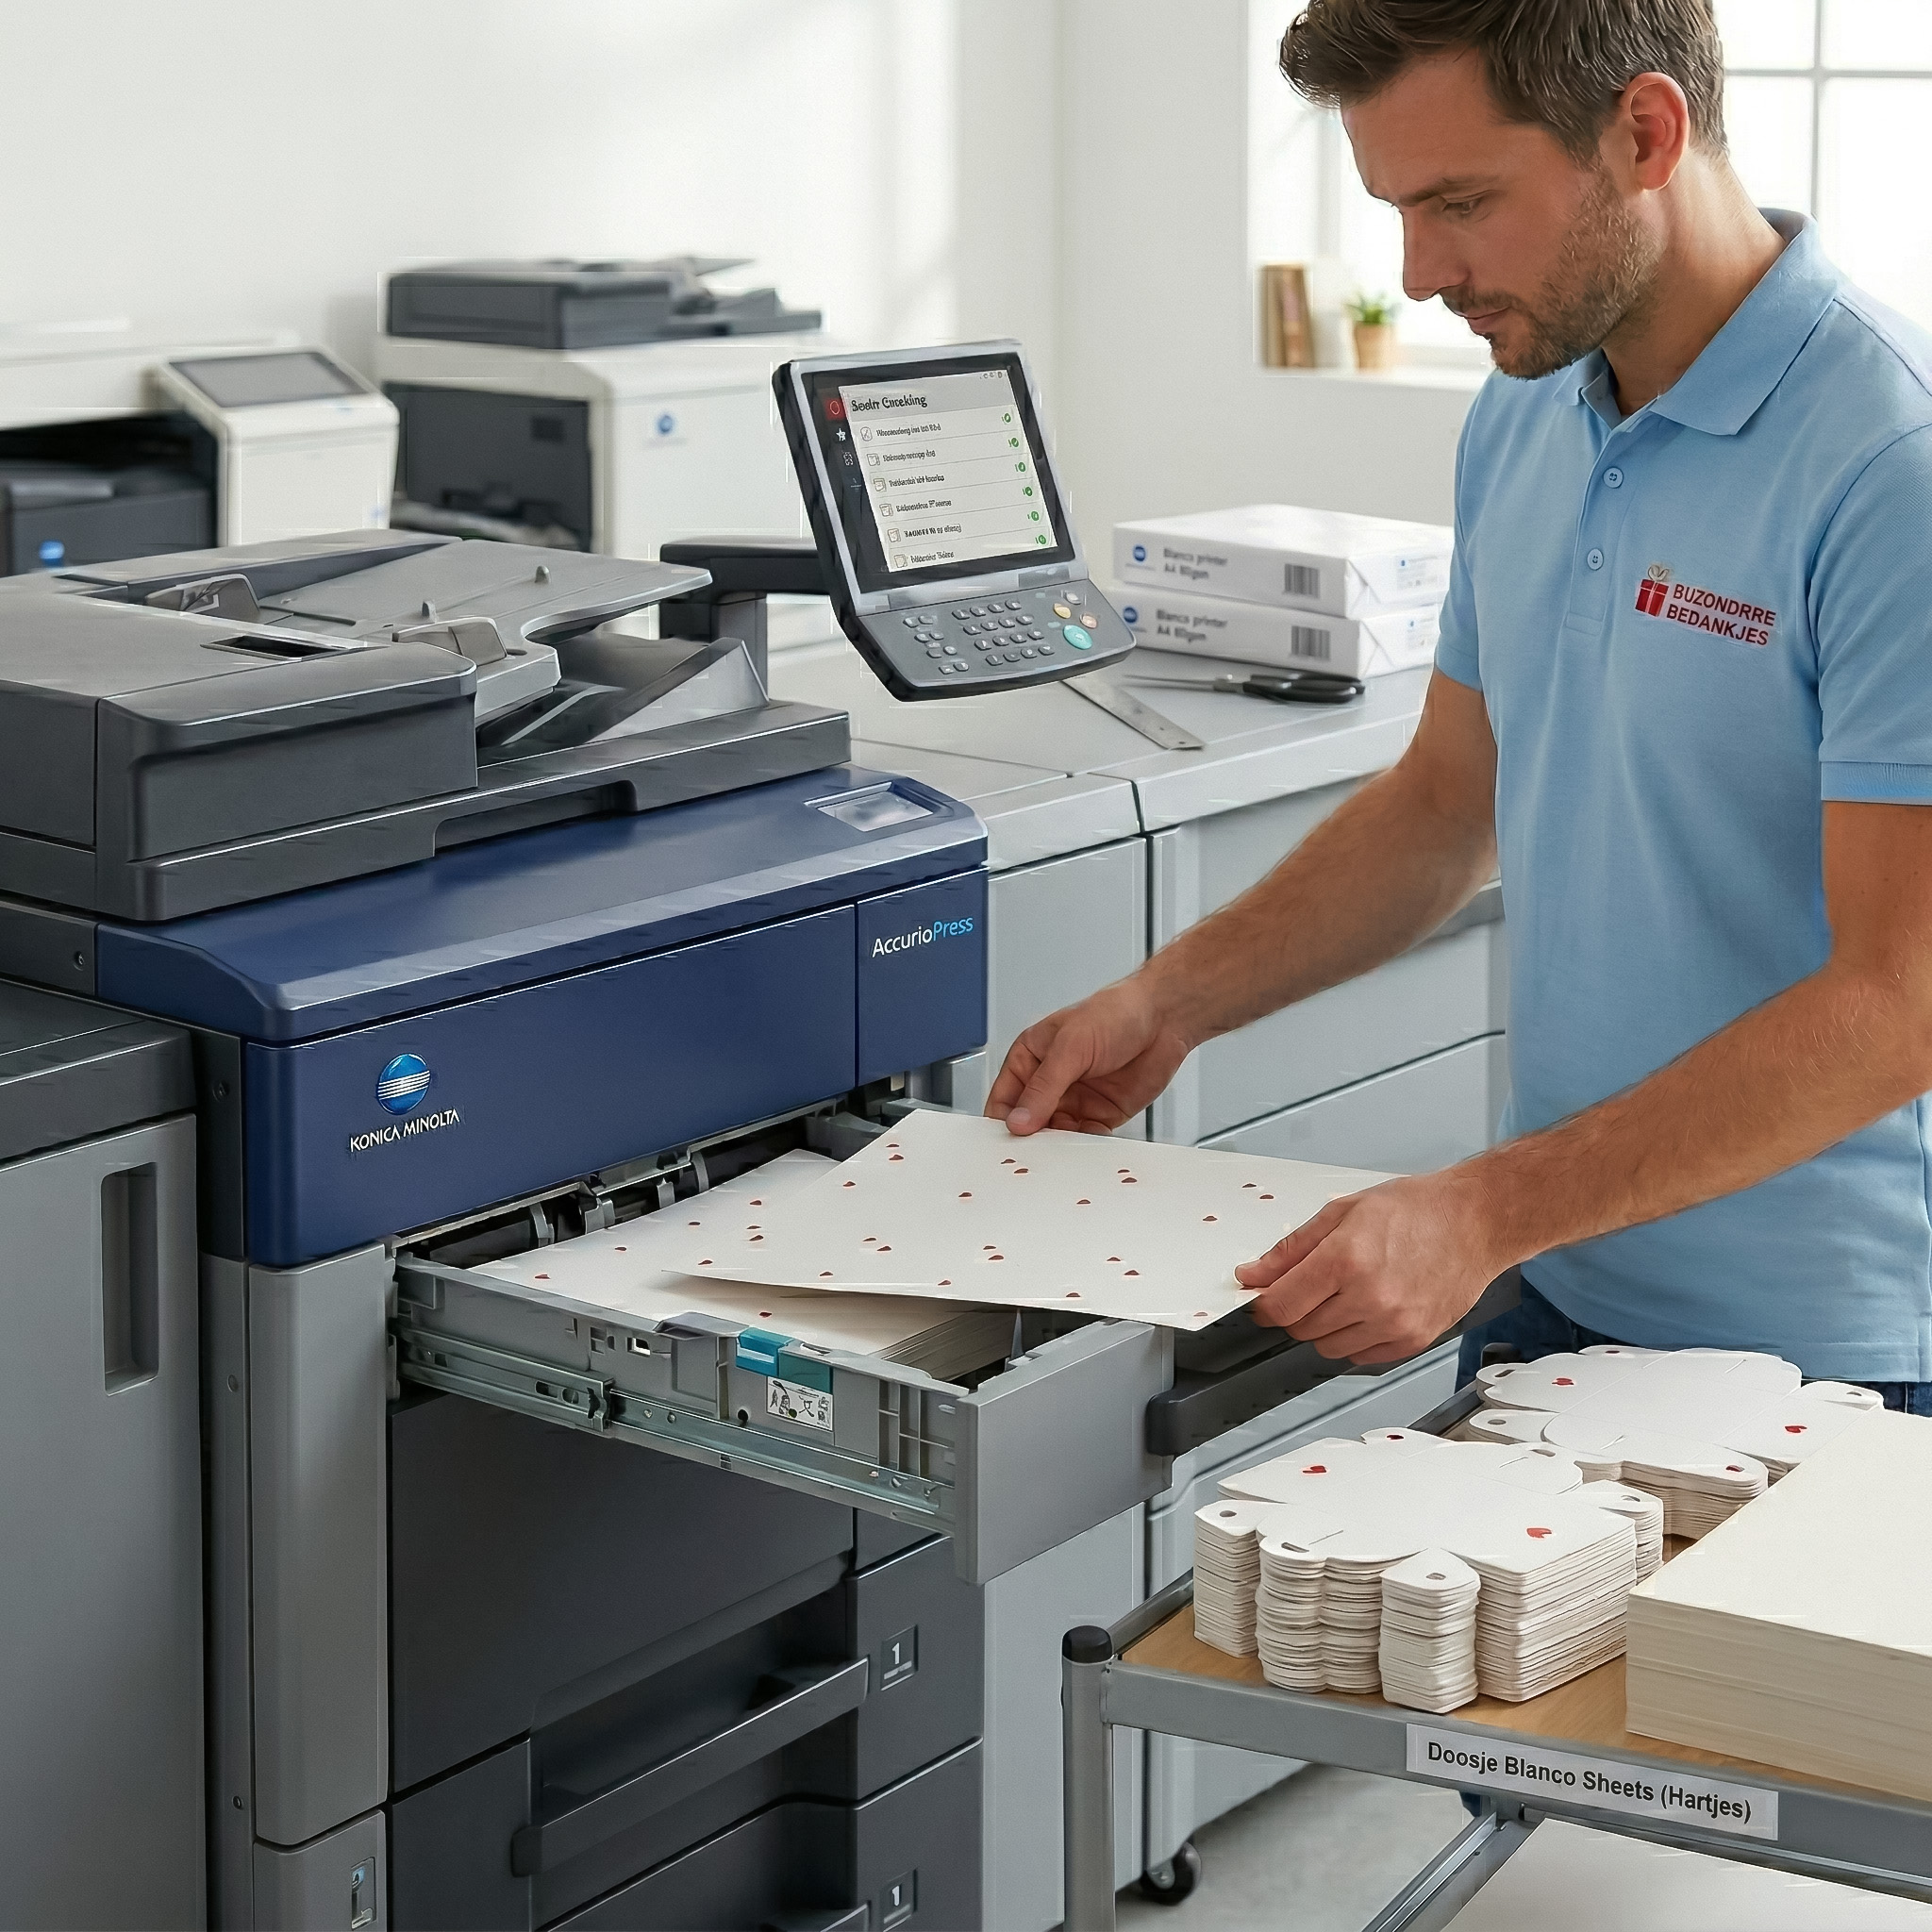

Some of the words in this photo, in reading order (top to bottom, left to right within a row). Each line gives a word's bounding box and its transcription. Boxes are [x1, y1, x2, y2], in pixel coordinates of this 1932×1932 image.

[1666, 604, 1769, 646] BEDANKJES
[1673, 583, 1776, 626] BUZONDRRE
[872, 917, 974, 958] AccurioPress
[350, 1124, 401, 1153] KONICA
[403, 1108, 460, 1138] MINOLTA
[1427, 1741, 1498, 1774] Doosje
[1505, 1756, 1576, 1786] Blanco
[1582, 1770, 1655, 1801] Sheets
[1660, 1784, 1752, 1824] (Hartjes)
